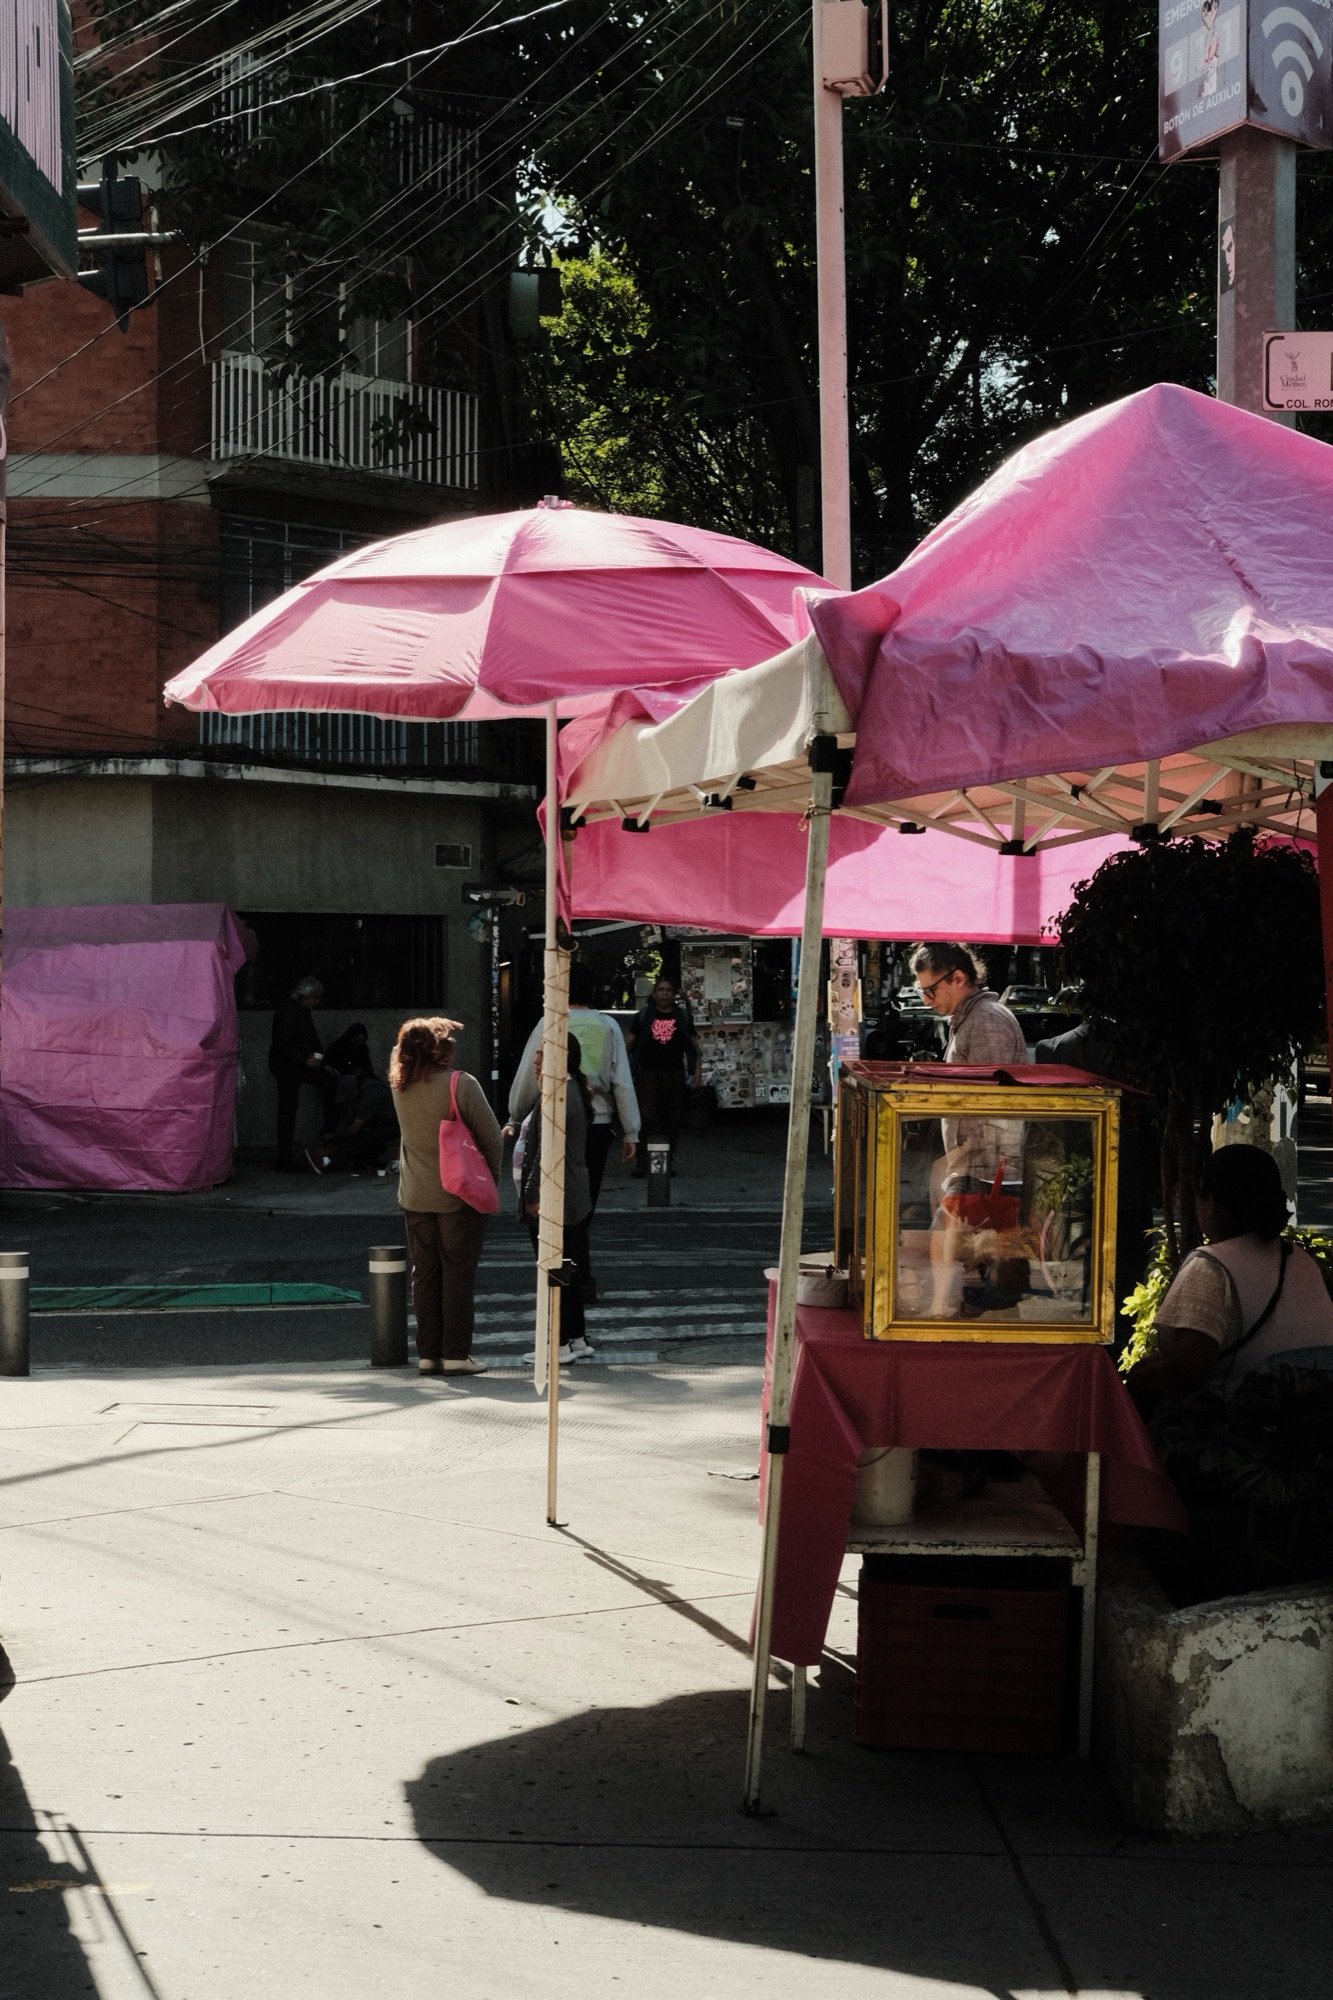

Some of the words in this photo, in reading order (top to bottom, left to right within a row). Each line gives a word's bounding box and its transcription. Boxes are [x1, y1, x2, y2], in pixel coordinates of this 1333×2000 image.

[1163, 107, 1191, 135] BOTÓN
[1192, 100, 1204, 118] DE
[1205, 82, 1241, 112] AUXILIO
[1286, 399, 1311, 409] COL.
